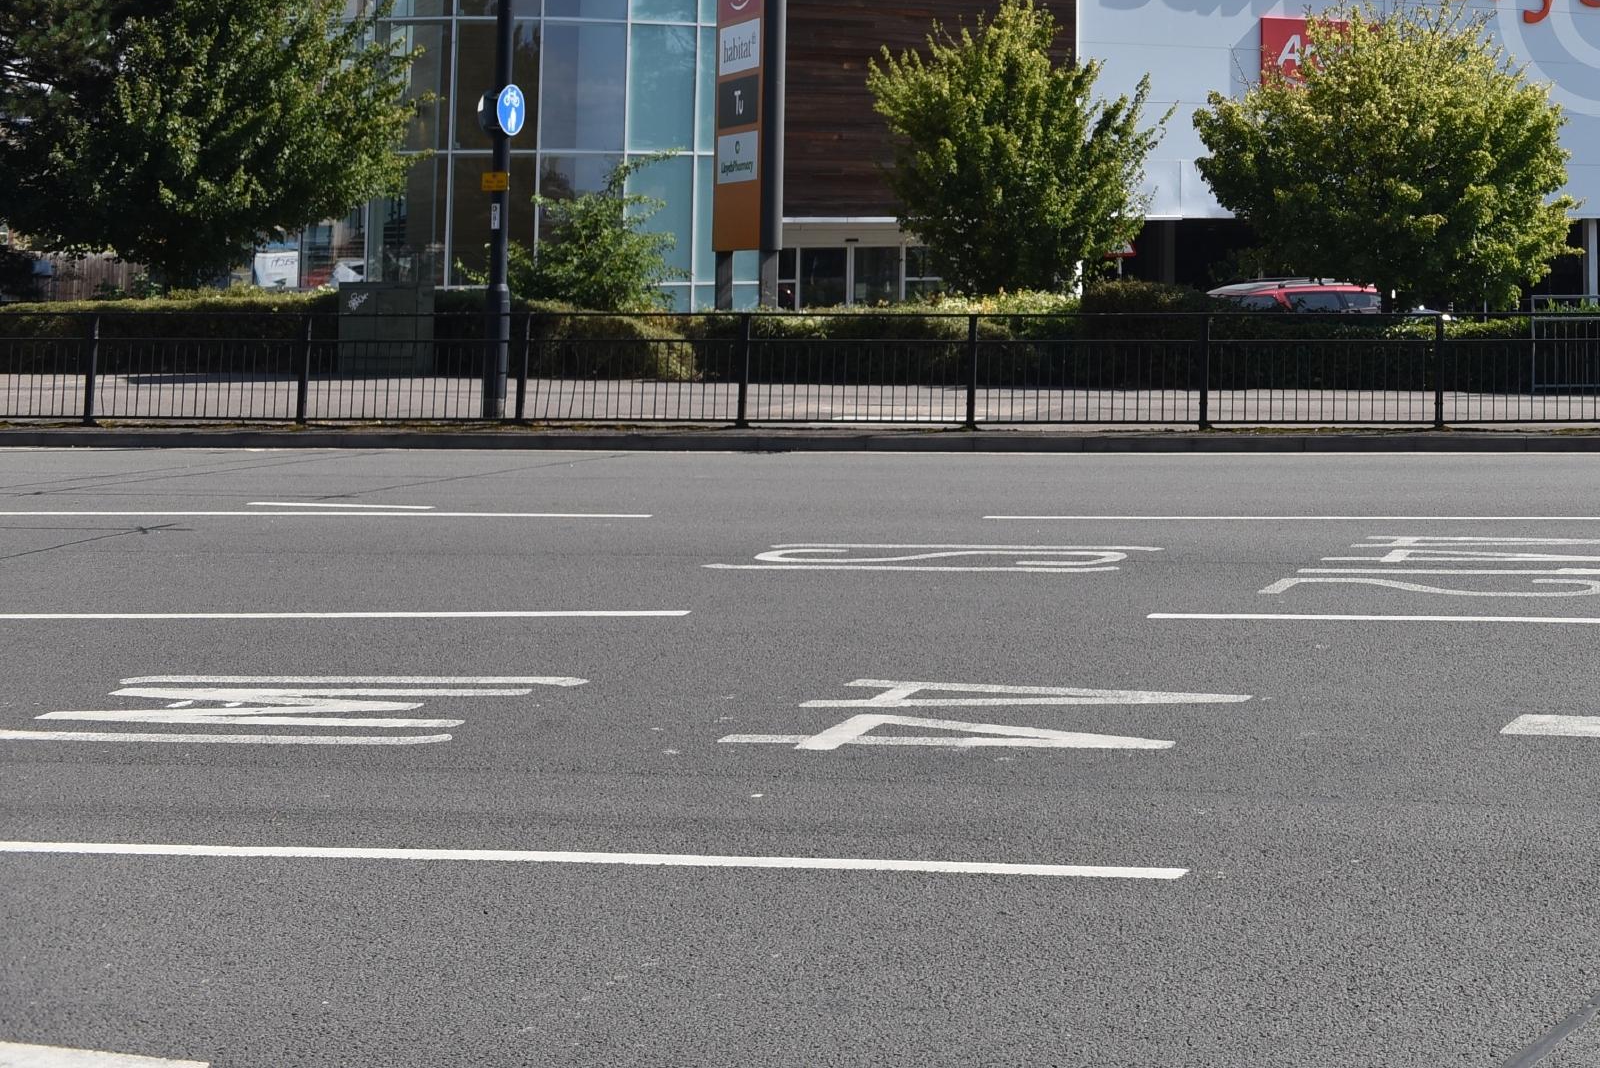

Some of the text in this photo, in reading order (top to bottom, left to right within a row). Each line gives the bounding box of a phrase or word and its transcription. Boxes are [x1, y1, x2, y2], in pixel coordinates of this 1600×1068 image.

[723, 36, 751, 64] habitat
[734, 90, 744, 116] Tu
[718, 679, 1254, 750] A4
